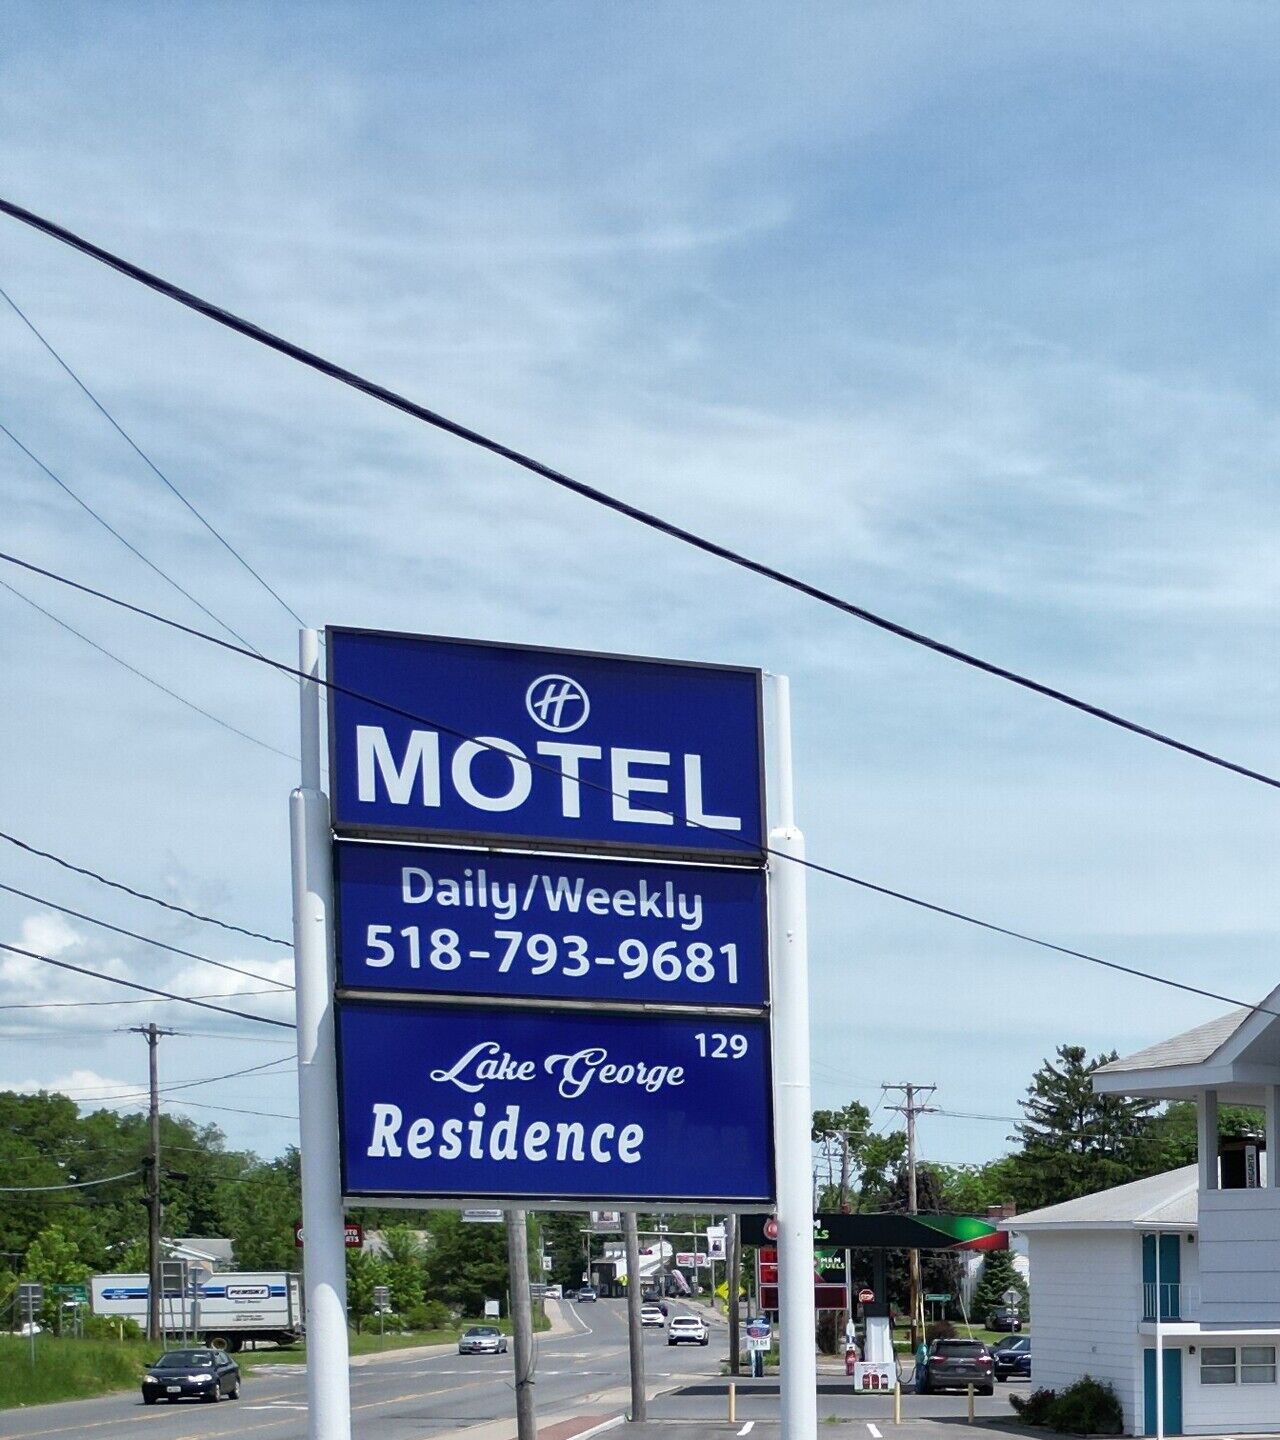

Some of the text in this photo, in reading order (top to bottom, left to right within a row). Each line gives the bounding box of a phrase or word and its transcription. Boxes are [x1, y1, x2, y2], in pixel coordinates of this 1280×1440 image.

[356, 724, 742, 831] MOTEL
[402, 866, 703, 931] Daily/Weekly
[365, 924, 738, 984] 518-793-9681
[429, 1041, 685, 1099] Lake George
[694, 1032, 748, 1059] 129
[367, 1102, 644, 1163] Residence
